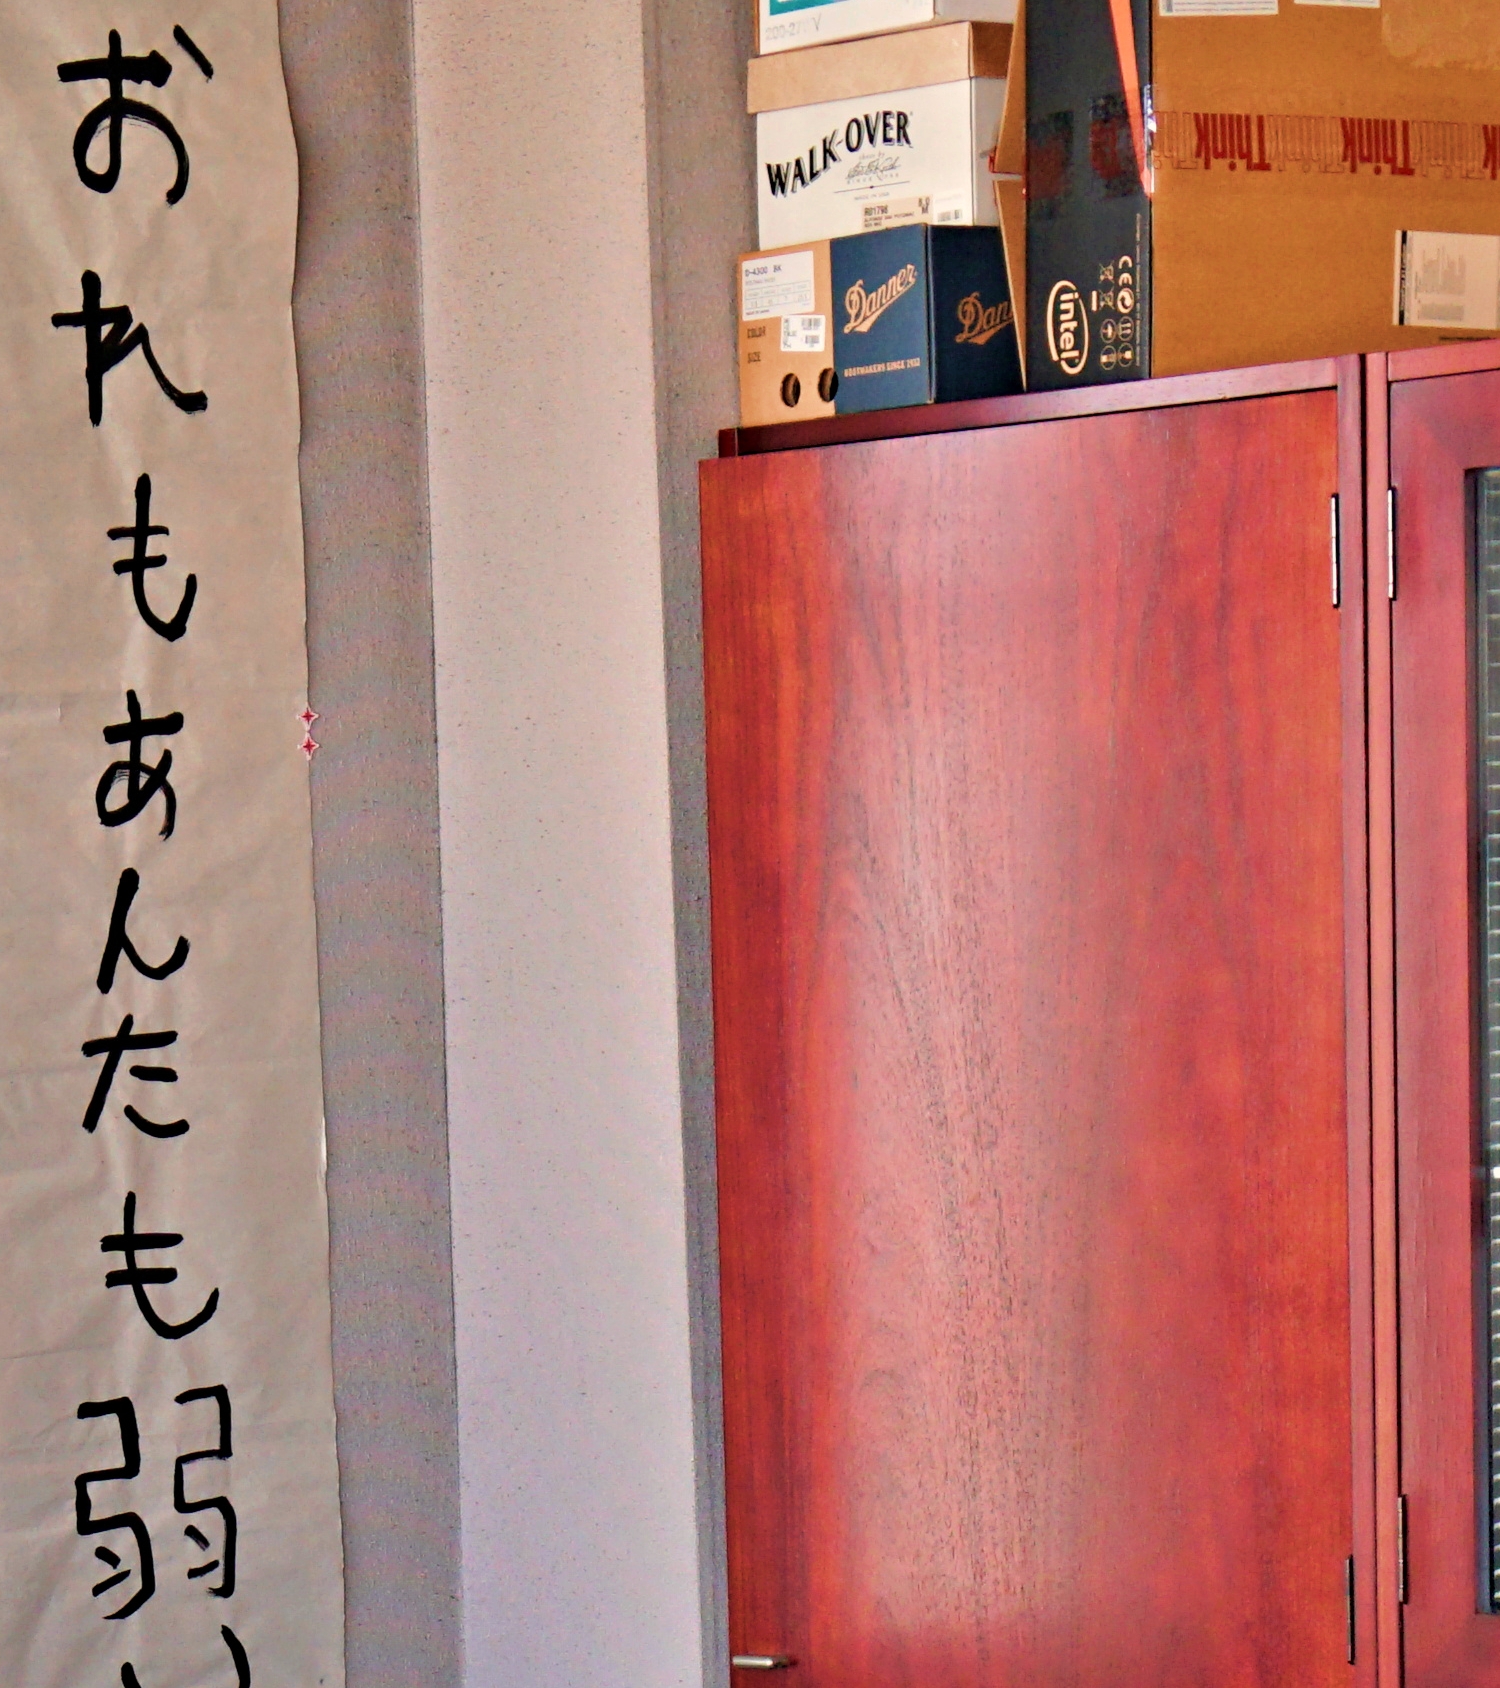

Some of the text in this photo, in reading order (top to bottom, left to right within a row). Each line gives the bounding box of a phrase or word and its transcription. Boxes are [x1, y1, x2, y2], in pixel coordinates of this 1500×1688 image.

[765, 110, 913, 198] WALK-OVER
[1193, 112, 1271, 171] Think
[1341, 117, 1415, 176] Think
[843, 263, 919, 334] Danner
[1058, 291, 1079, 363] intel
